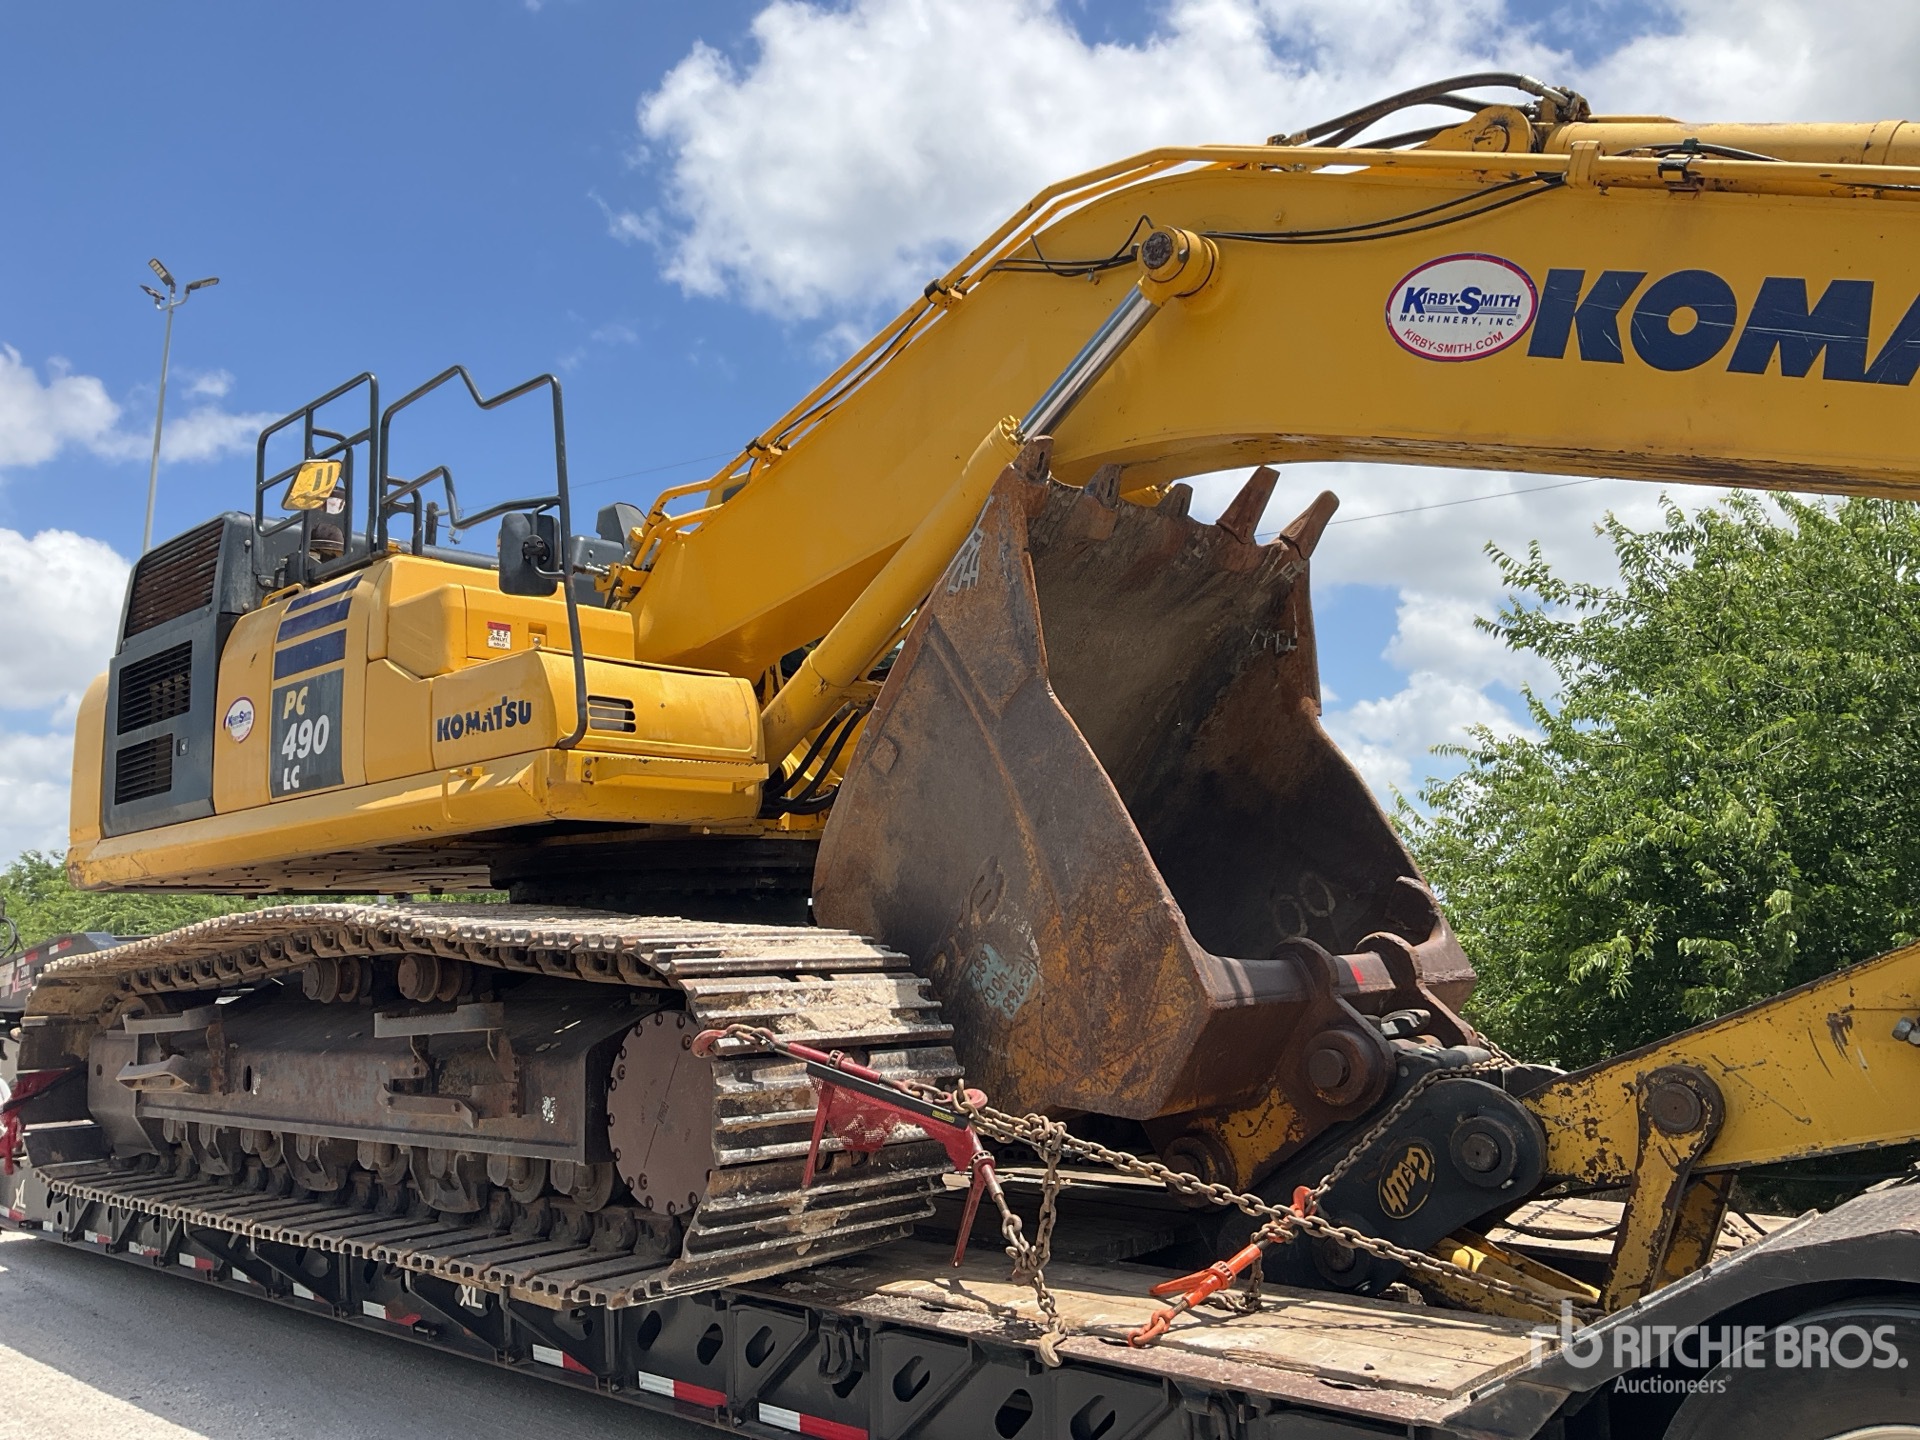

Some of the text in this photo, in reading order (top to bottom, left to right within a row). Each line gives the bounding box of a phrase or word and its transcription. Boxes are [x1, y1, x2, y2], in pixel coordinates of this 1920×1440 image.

[1402, 286, 1521, 315] KIRBY-SMITH
[1399, 314, 1482, 326] MACHINERY,
[1403, 328, 1504, 354] KIRBY-SMITH.COM
[283, 686, 308, 719] PC
[437, 696, 531, 742] KOMATSU
[281, 714, 330, 760] 490
[283, 765, 300, 790] LC
[12, 1179, 27, 1210] XL
[460, 1284, 483, 1309] XL
